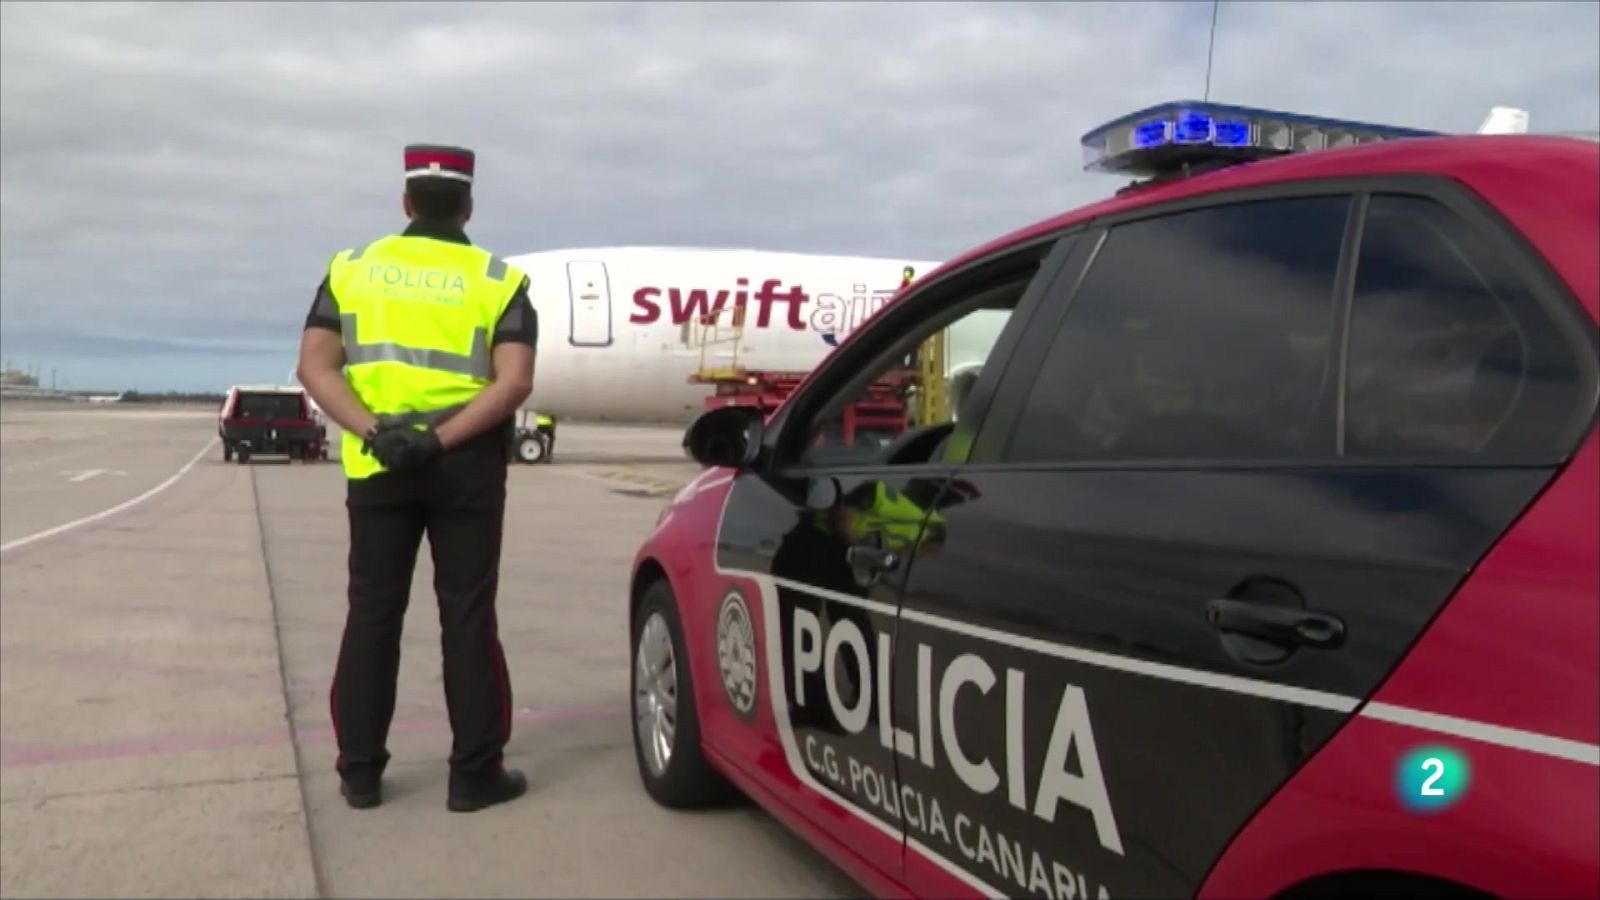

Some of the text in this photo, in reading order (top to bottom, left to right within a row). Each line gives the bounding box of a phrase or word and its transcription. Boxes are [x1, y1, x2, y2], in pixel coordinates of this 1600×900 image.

[368, 264, 466, 294] POLICIA
[793, 607, 1125, 857] POLICIA
[805, 735, 846, 786] C.G.
[848, 756, 951, 844] POLICIA
